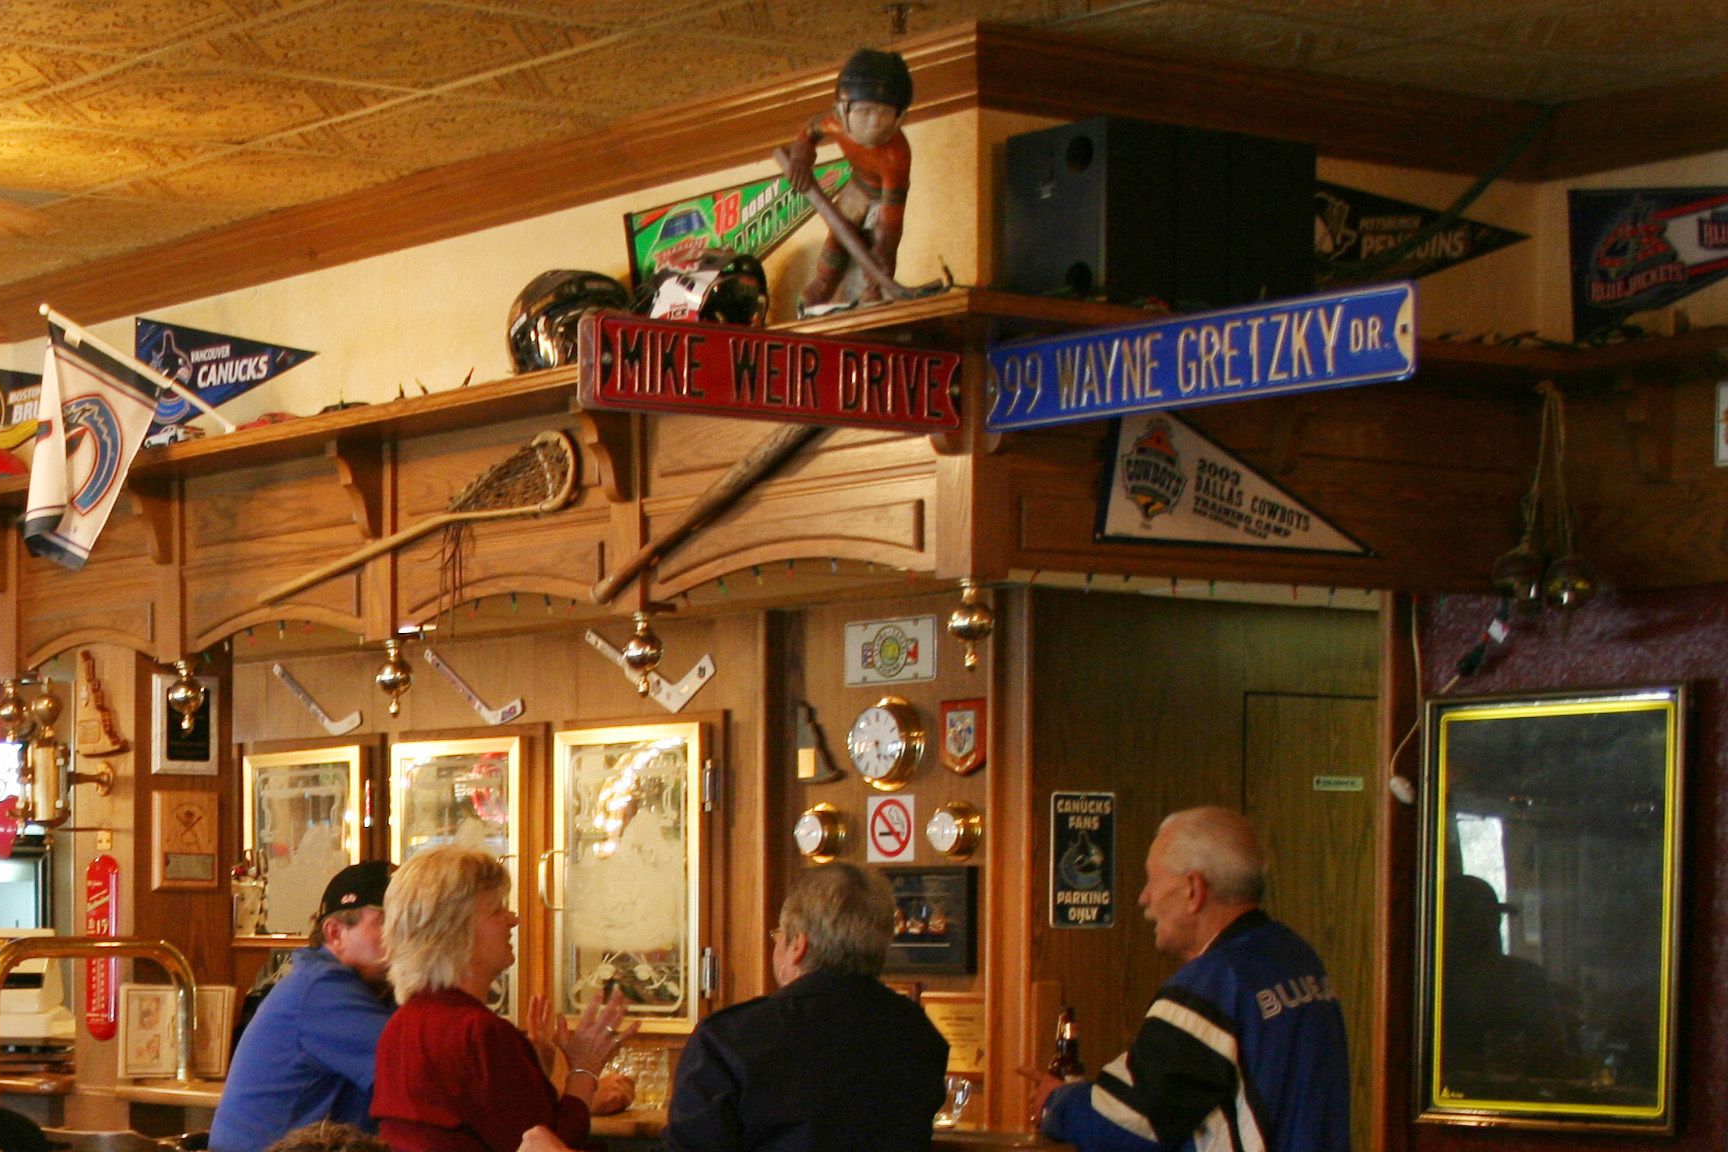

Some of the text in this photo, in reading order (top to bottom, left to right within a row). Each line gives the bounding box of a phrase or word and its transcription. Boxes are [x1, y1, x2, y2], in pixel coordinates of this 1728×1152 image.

[713, 179, 780, 236] 18 BOBBY
[1361, 225, 1467, 260] PENUINS
[197, 355, 268, 389] CANUCKS
[616, 328, 946, 419] MIKE WEIR DRIVE
[1003, 352, 1043, 418] 99
[1056, 332, 1163, 411] WAYNE
[1177, 304, 1345, 396] GRETZKY
[1126, 458, 1183, 497] COWBOYS
[1197, 458, 1241, 486] 2003
[1195, 475, 1312, 533] DALLAS COWBOYS
[1056, 799, 1112, 815] CANUCKS
[1068, 815, 1100, 830] FANS
[1056, 890, 1110, 906] PARKING
[1068, 906, 1099, 921] ONLY
